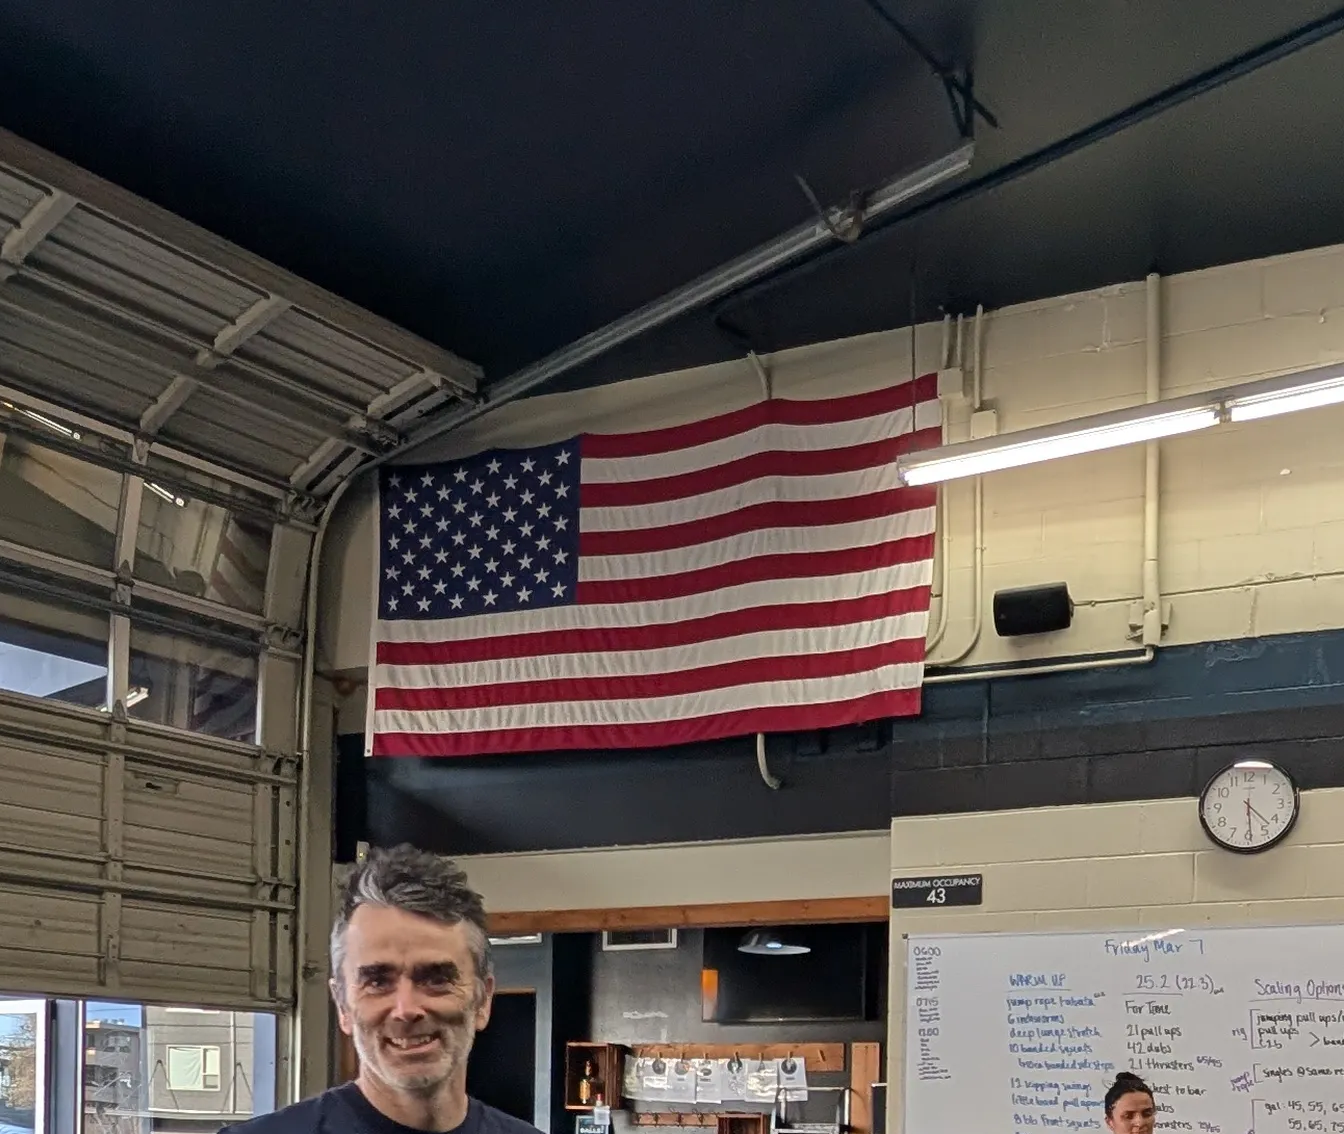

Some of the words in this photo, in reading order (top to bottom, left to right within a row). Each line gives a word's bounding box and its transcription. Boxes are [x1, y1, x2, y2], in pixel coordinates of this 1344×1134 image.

[1230, 776, 1239, 787] 11
[1244, 772, 1255, 783] 12
[1217, 787, 1230, 798] 10
[1272, 783, 1280, 795] 2
[1214, 802, 1222, 813] 9
[1276, 798, 1284, 809] 3
[1217, 816, 1226, 827] 8
[1271, 813, 1279, 823] 4
[1230, 827, 1237, 838] 7
[1244, 829, 1253, 840] 6
[1260, 825, 1268, 836] 5
[893, 880, 931, 889] MAXIMUM
[932, 877, 981, 888] OCCUPANCY
[926, 888, 946, 904] 43
[913, 946, 941, 956] 0600
[1105, 938, 1149, 962] Friday
[1153, 940, 1184, 954] Mar
[1189, 939, 1204, 955] 7
[1009, 973, 1047, 987] WARM
[1051, 973, 1066, 987] UP
[1136, 974, 1171, 989] 25.2
[1255, 978, 1302, 1004] Scaling
[1125, 1000, 1144, 1014] For
[1145, 1001, 1172, 1015] Time
[1127, 1024, 1139, 1036] 21
[1127, 1041, 1146, 1054] 42
[1128, 1058, 1143, 1070] 21
[1176, 1084, 1186, 1094] to
[1187, 1085, 1208, 1096] bar
